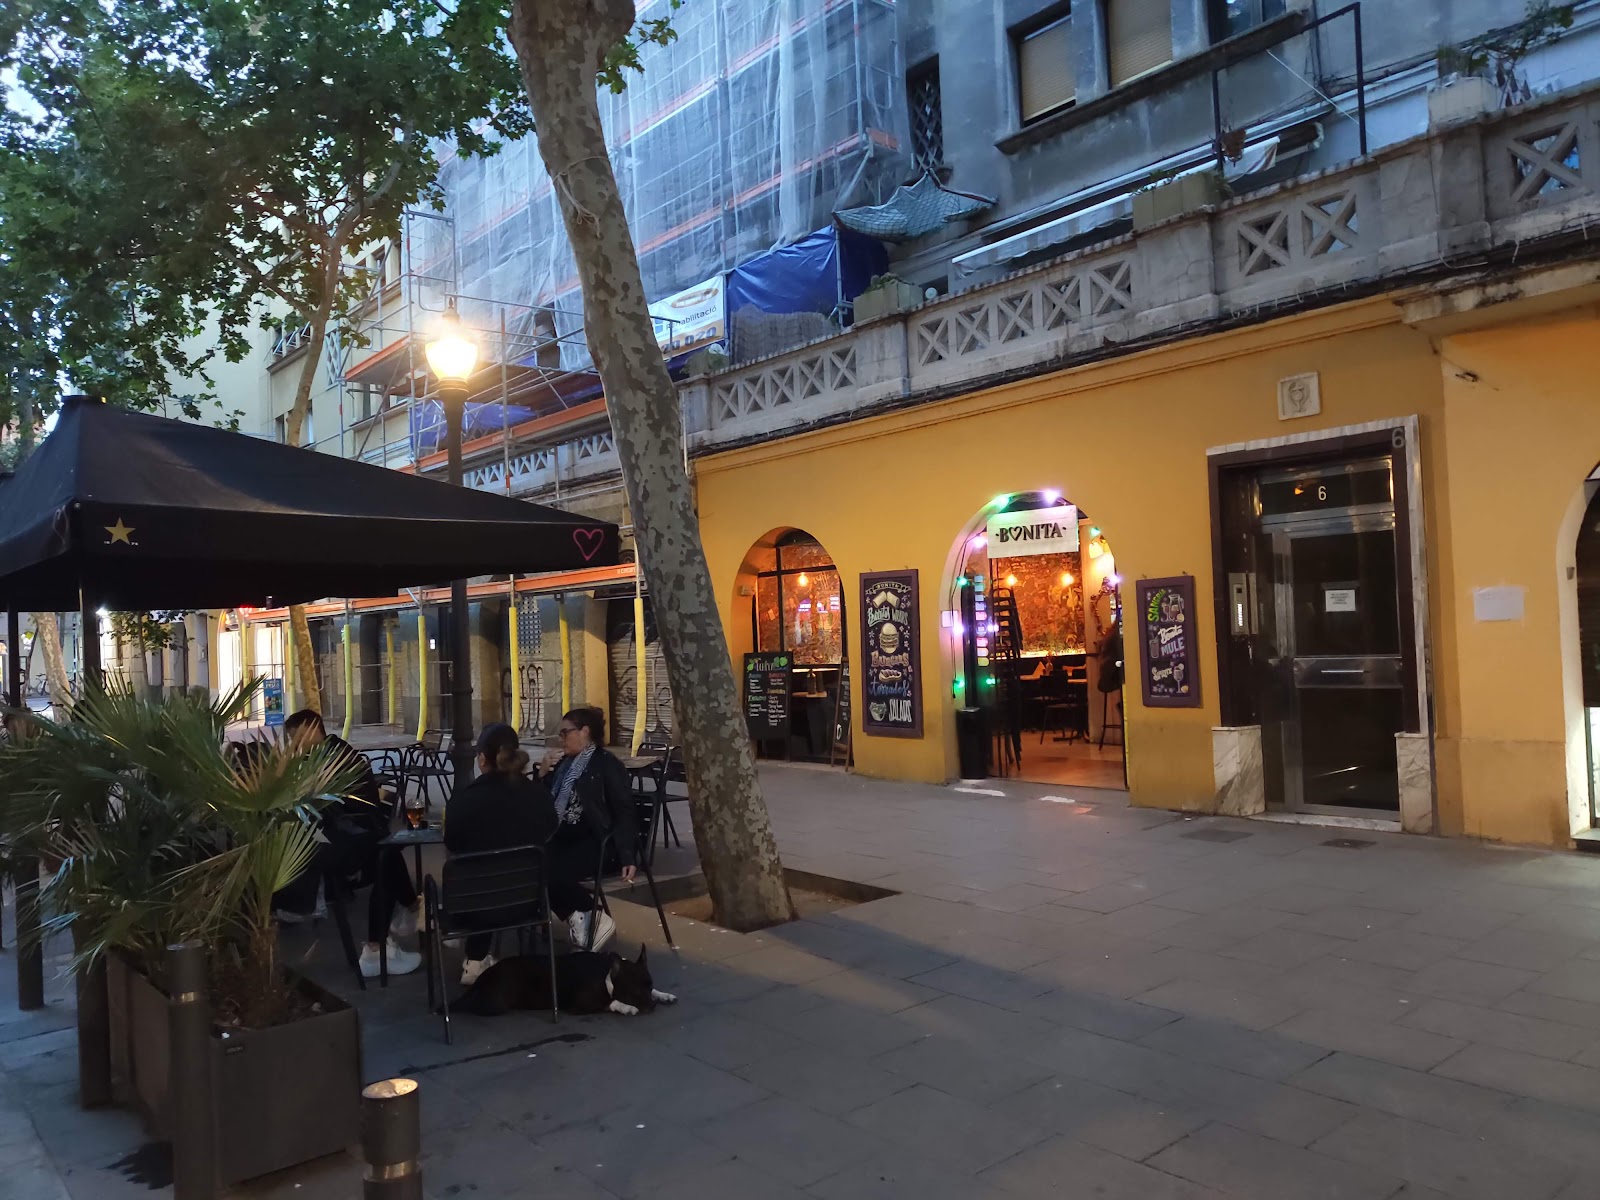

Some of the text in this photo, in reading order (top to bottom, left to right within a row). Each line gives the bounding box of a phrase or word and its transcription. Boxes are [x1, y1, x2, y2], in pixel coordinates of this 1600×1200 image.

[685, 326, 717, 346] 020
[1391, 427, 1405, 448] 6
[1318, 486, 1327, 501] 6
[1160, 637, 1185, 656] MULE
